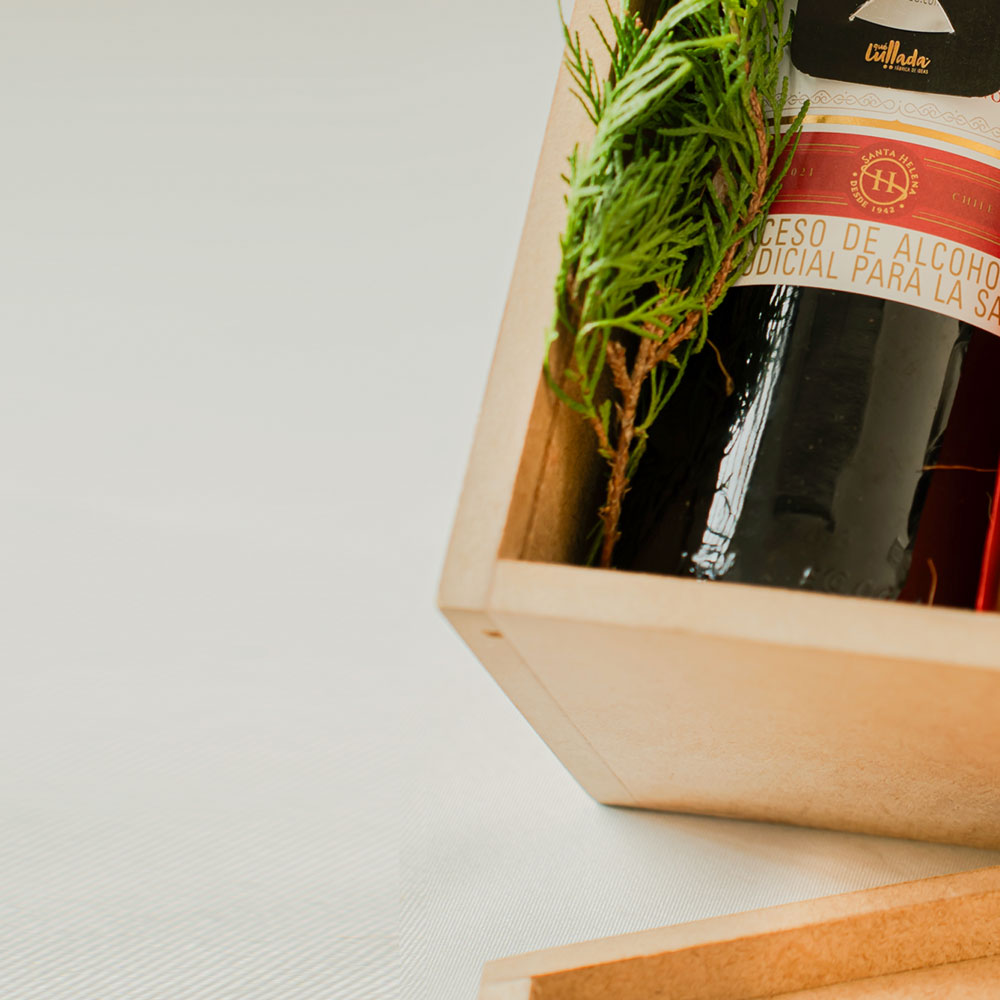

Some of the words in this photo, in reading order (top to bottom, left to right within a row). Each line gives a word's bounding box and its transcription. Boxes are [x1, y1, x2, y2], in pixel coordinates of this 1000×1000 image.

[861, 148, 896, 164] SANTA
[899, 154, 919, 195] HELENA
[850, 180, 868, 208] DESDE
[872, 206, 895, 214] 1942
[752, 218, 827, 247] CESO
[843, 223, 880, 254] DE
[851, 255, 921, 296] PARA
[934, 274, 963, 310] LA
